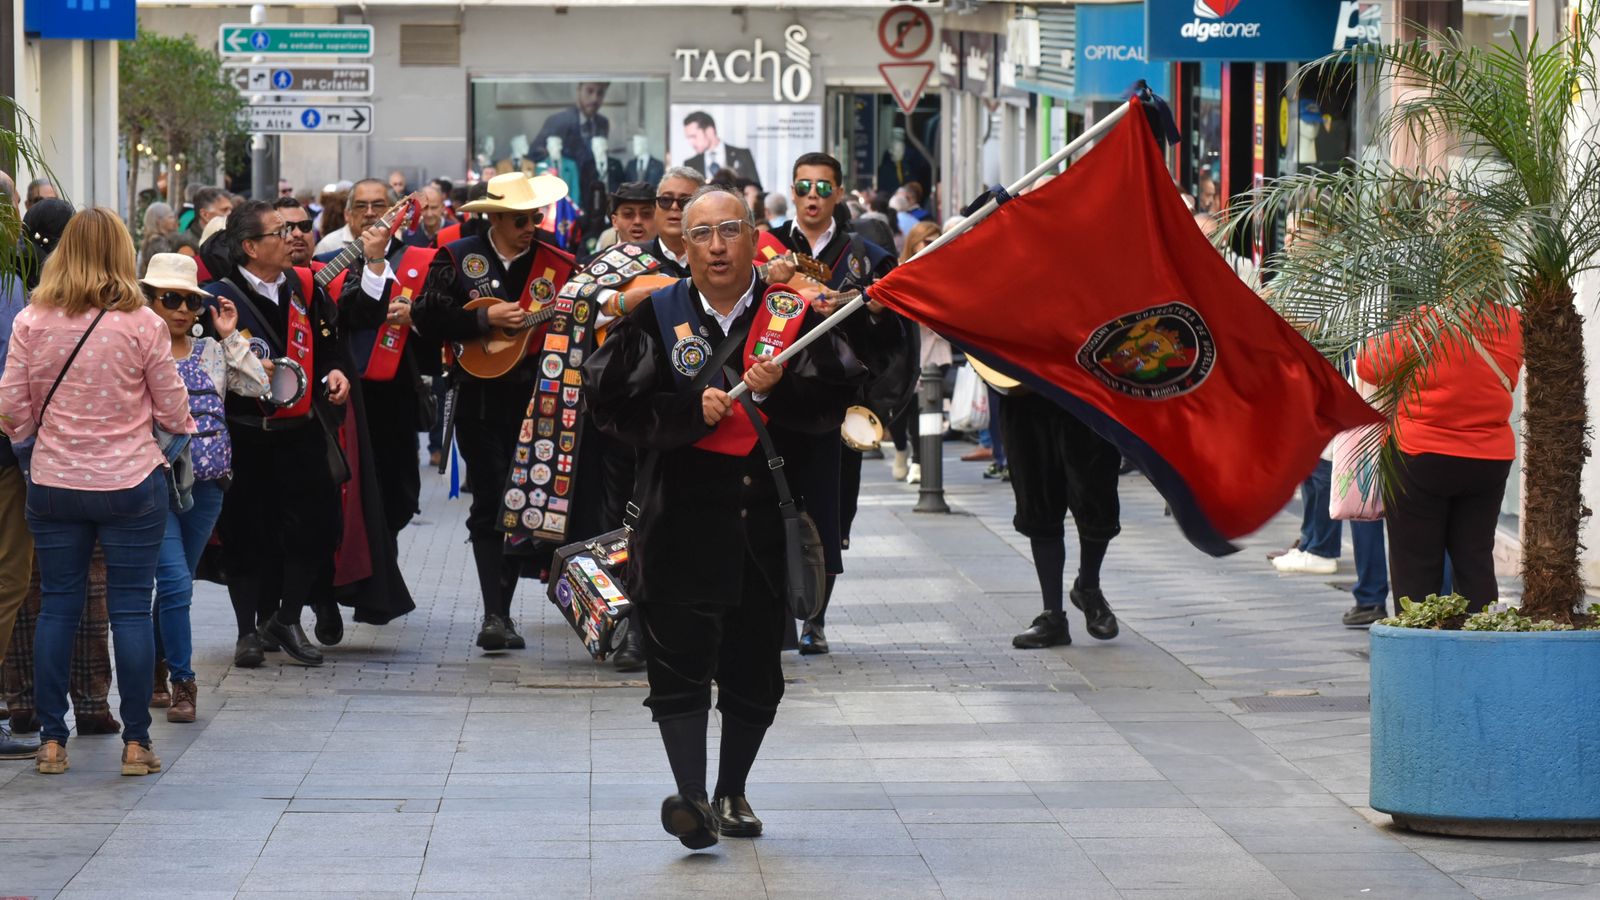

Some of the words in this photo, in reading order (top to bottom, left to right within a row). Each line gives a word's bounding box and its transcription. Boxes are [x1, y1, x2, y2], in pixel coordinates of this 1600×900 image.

[326, 43, 368, 51] superiores
[333, 71, 366, 79] parque
[319, 80, 366, 90] Cristina
[266, 120, 292, 128] Alta
